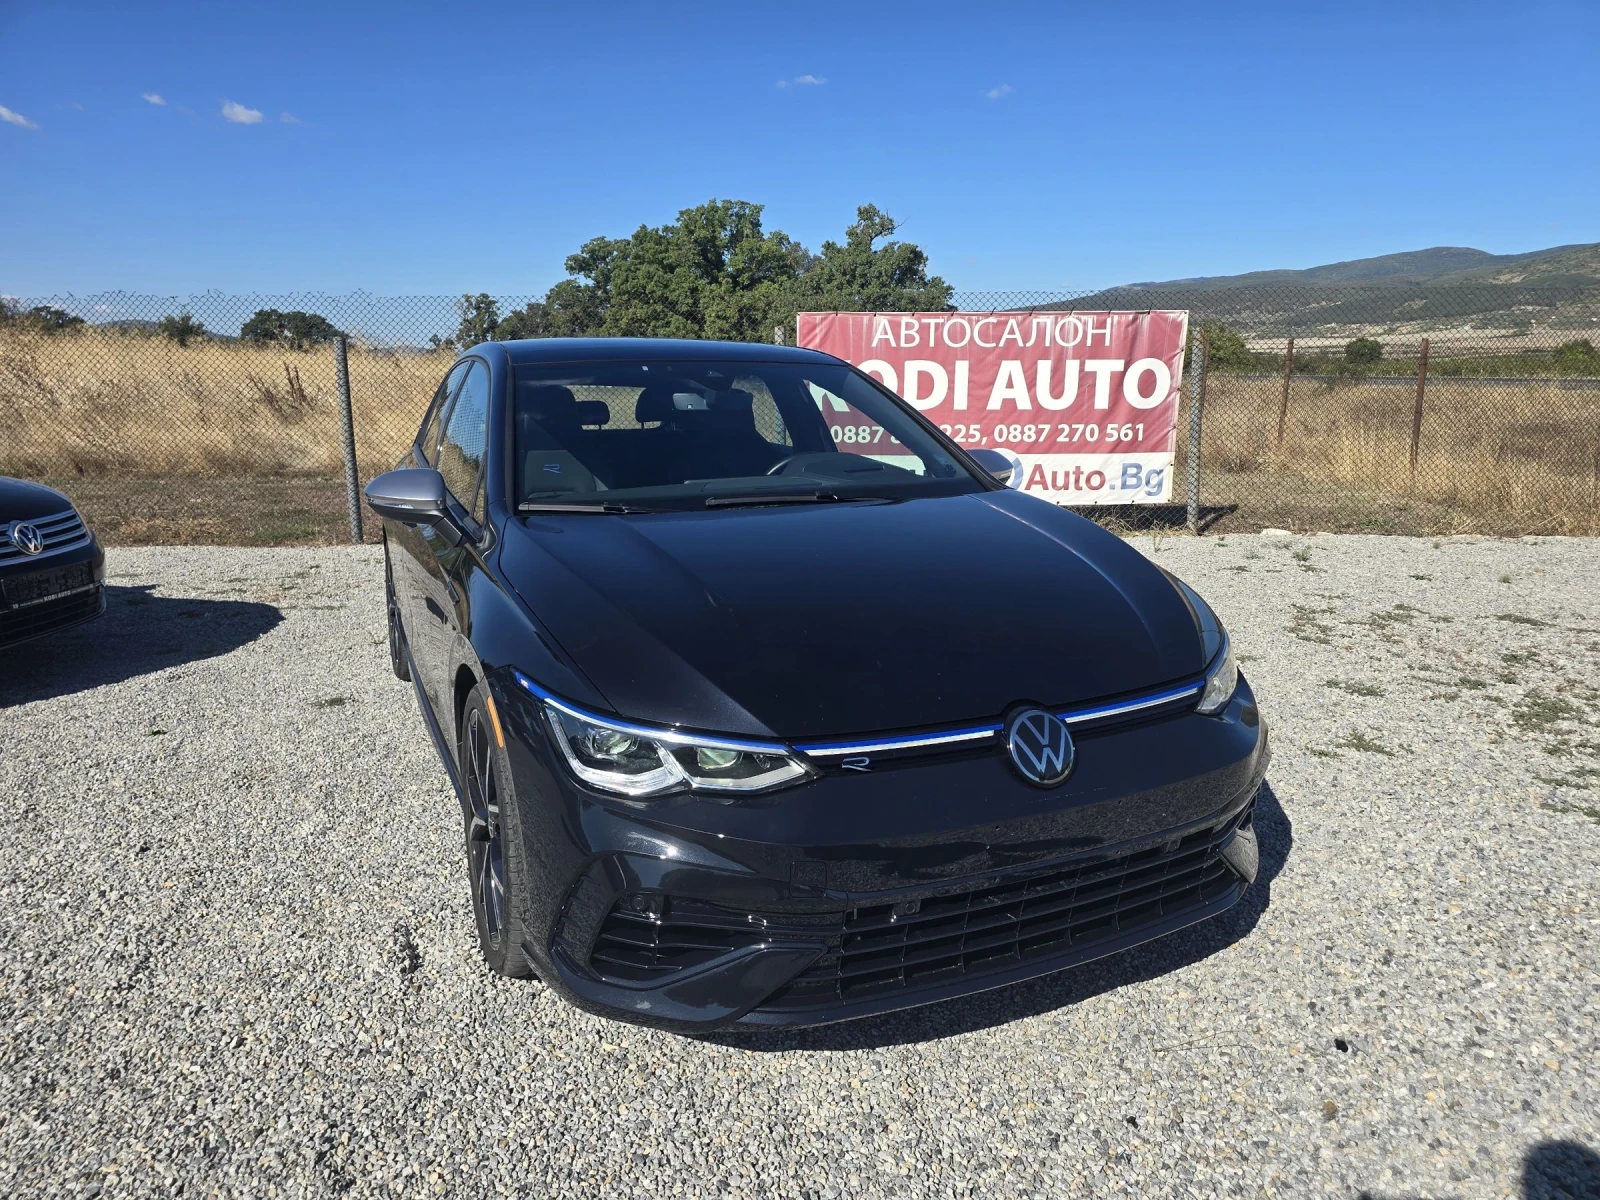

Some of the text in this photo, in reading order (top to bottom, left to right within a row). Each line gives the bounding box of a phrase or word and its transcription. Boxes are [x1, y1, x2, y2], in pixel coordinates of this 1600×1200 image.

[871, 317, 1112, 348] АВТОСАЛОН
[986, 357, 1172, 411] AUTO
[830, 425, 885, 444] 0887
[993, 423, 1052, 443] 0887
[1056, 423, 1100, 443] 270
[1104, 422, 1145, 442] 561
[1024, 462, 1164, 497] Auto.Bg
[1011, 711, 1073, 780] VW
